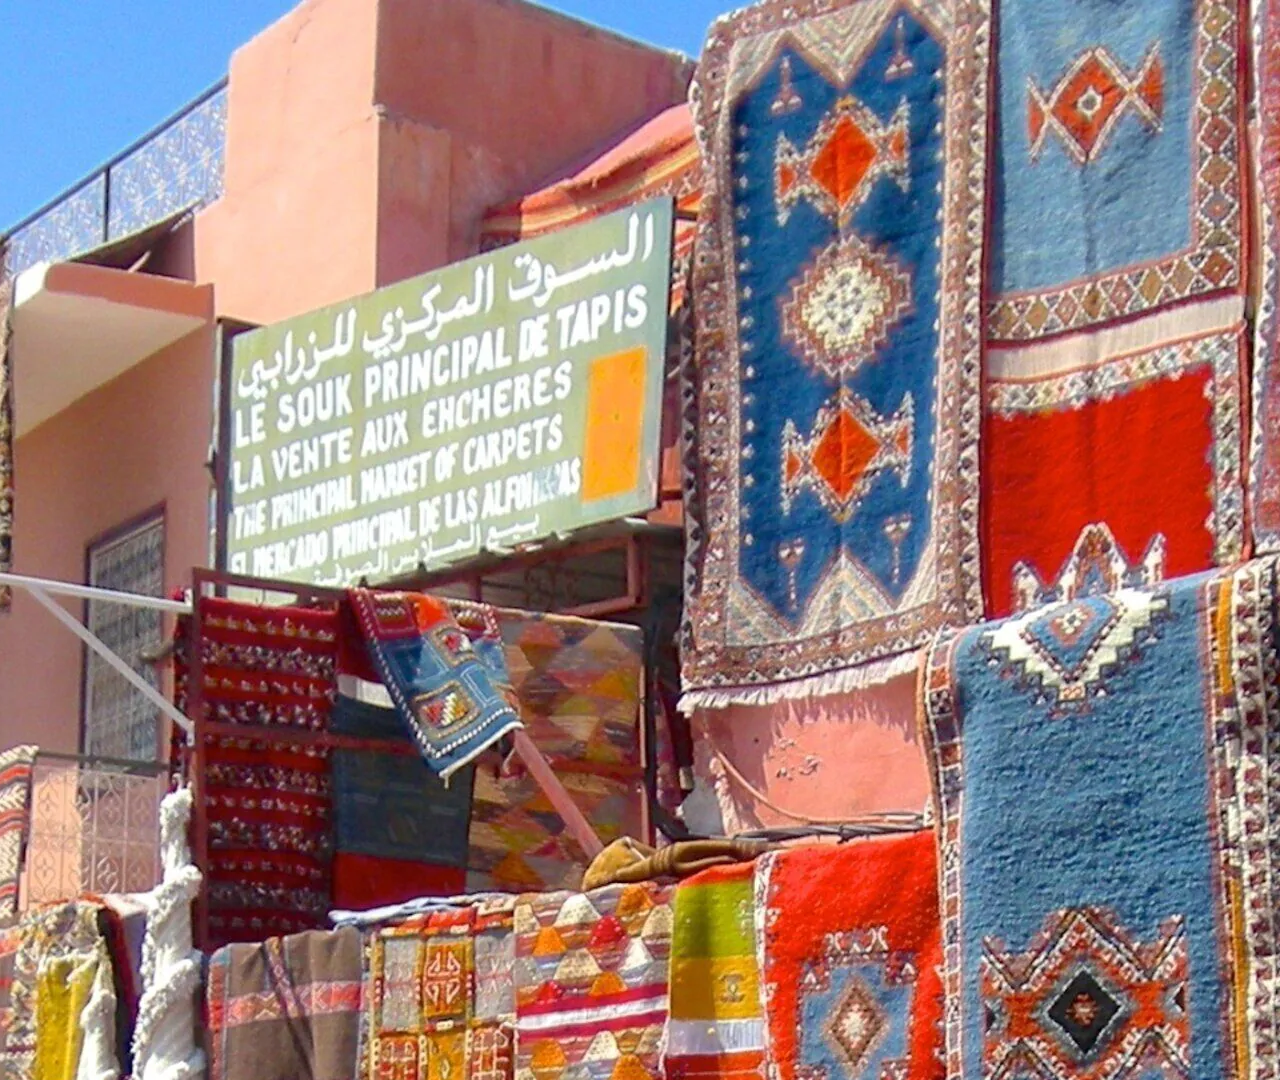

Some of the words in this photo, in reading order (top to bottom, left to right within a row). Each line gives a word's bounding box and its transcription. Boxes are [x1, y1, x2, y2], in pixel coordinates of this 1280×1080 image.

[508, 212, 654, 308] السوق
[237, 307, 356, 398] للزرابي
[362, 263, 495, 359] المركزي
[235, 402, 267, 448] LE
[277, 373, 353, 433] SOUK
[365, 326, 512, 408] PRINCIPAL
[518, 313, 550, 363] DE
[556, 284, 648, 350] TAPIS
[233, 454, 265, 494] LA
[272, 426, 354, 482] VENTE
[360, 409, 410, 457] AUX
[422, 360, 573, 438] ENCHERES
[233, 499, 267, 540] THE
[271, 474, 357, 531] PRINCIPAL
[360, 451, 433, 504] MARKET
[434, 442, 460, 483] OF
[463, 413, 563, 475] CARPETS
[252, 530, 328, 578] MERCADO
[332, 505, 417, 560] PRINCIPAL
[419, 495, 441, 537] DE
[444, 486, 478, 528] LAS
